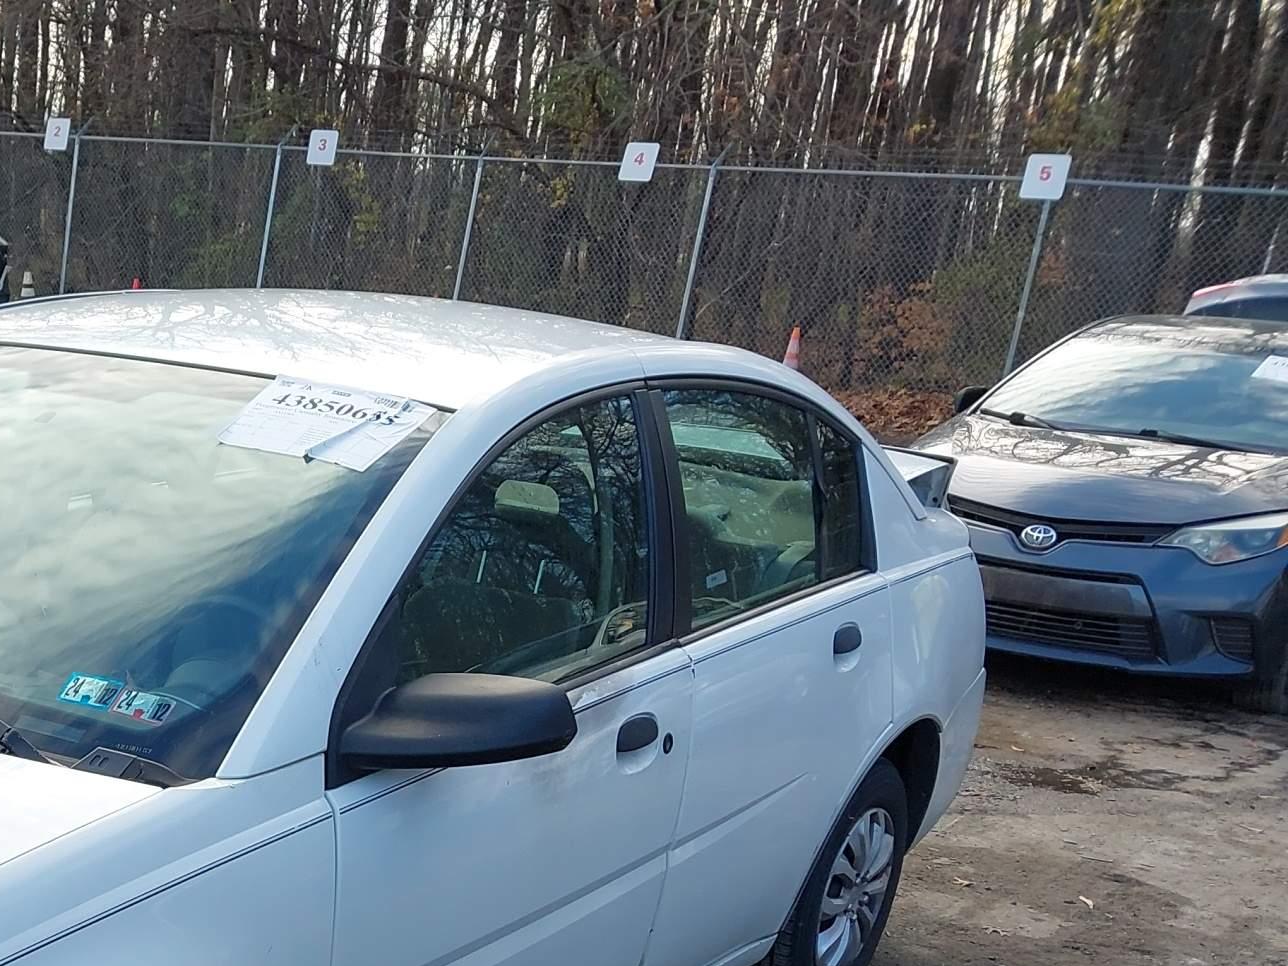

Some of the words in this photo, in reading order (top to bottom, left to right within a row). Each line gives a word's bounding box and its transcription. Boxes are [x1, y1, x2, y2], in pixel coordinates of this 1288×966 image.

[53, 126, 61, 137] 2
[318, 138, 328, 151] 3
[634, 152, 644, 166] 4
[1039, 165, 1053, 181] 5
[65, 677, 86, 698] 24
[96, 686, 118, 706] 12
[117, 689, 139, 711] 24
[152, 701, 172, 721] 12
